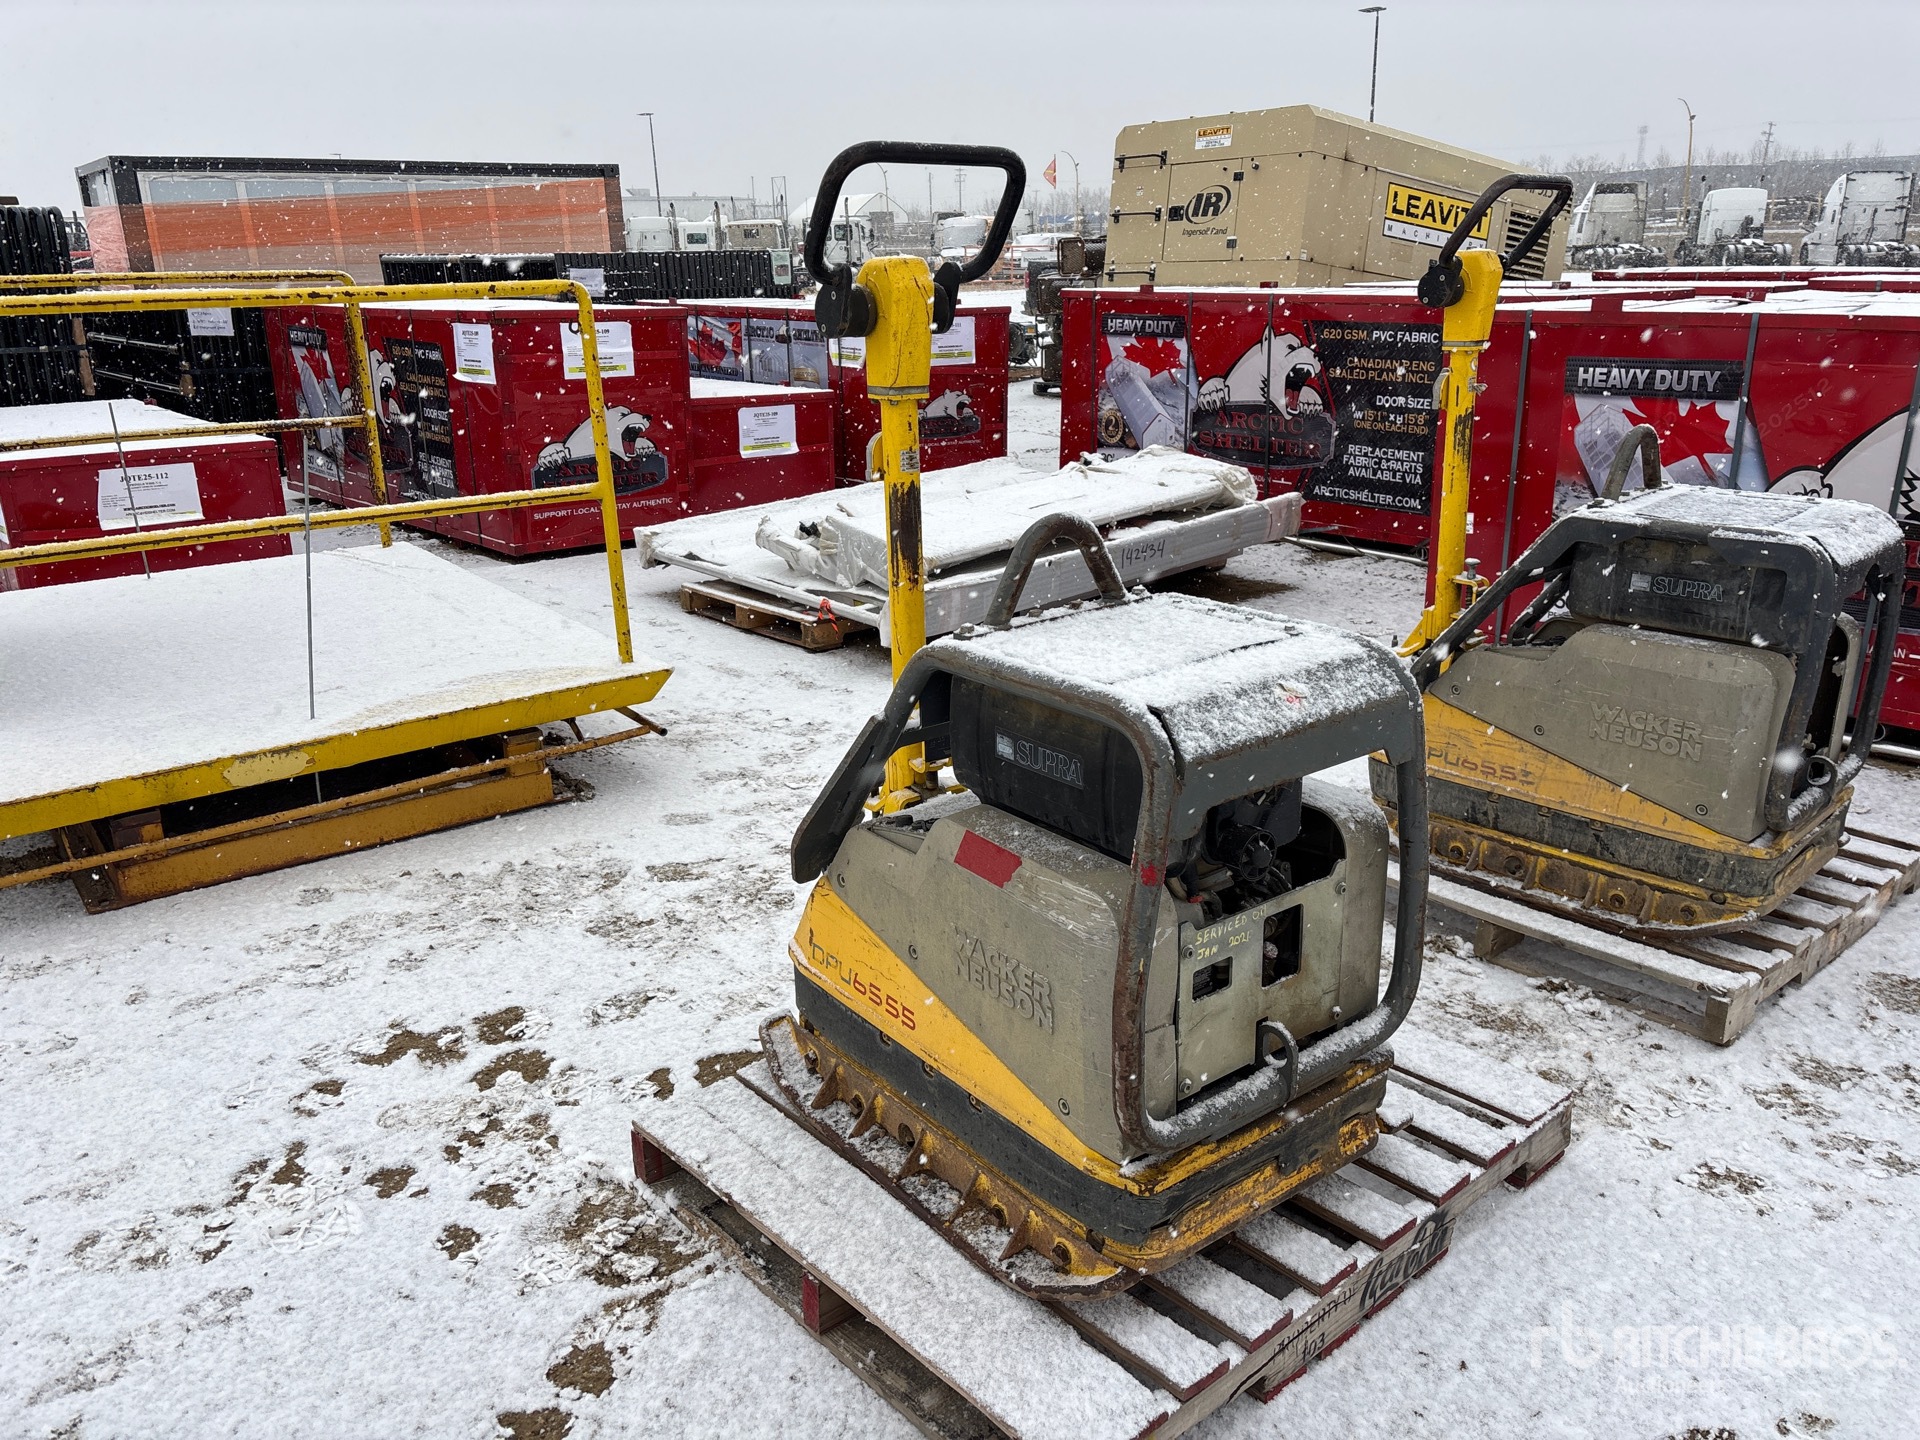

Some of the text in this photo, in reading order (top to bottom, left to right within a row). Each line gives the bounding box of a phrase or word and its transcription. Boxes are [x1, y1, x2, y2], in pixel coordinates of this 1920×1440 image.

[1191, 192, 1224, 217] IR
[1107, 318, 1177, 335] HEAVY DUTY
[1323, 328, 1342, 340] 620
[1372, 330, 1395, 342] PVC
[1396, 331, 1440, 344] FABRIC
[1328, 367, 1367, 380] SEALED
[1368, 371, 1401, 382] PLANS
[1346, 357, 1436, 372] CANADIAN P.ENG
[1577, 366, 1722, 393] HEAVY DUTY
[1376, 395, 1432, 410] DOOR SIZE
[1215, 410, 1305, 435] ARCTIC
[1372, 421, 1384, 431] ON
[1385, 422, 1407, 432] EACH
[1199, 429, 1321, 459] SHELTER
[1347, 444, 1425, 463] REPLACEMENT
[419, 451, 452, 469] RELACEMENT
[1342, 454, 1424, 474] FABRIC & PARTS
[120, 472, 169, 484] JQTE25-112
[1347, 466, 1422, 485] AVAILABLE VIA
[533, 508, 572, 520] SUPPORT
[573, 506, 600, 517] LOCAL
[632, 496, 674, 509] AUTHENTIC
[1121, 539, 1166, 570] 142434
[1652, 576, 1723, 602] SUPRA
[1589, 701, 1703, 744] WACKER
[1588, 720, 1702, 762] NEUSON
[1016, 739, 1083, 786] SUPRA
[1195, 914, 1248, 946] SERVICED
[953, 922, 1055, 1010] WACKER
[953, 950, 1054, 1036] NEUSON
